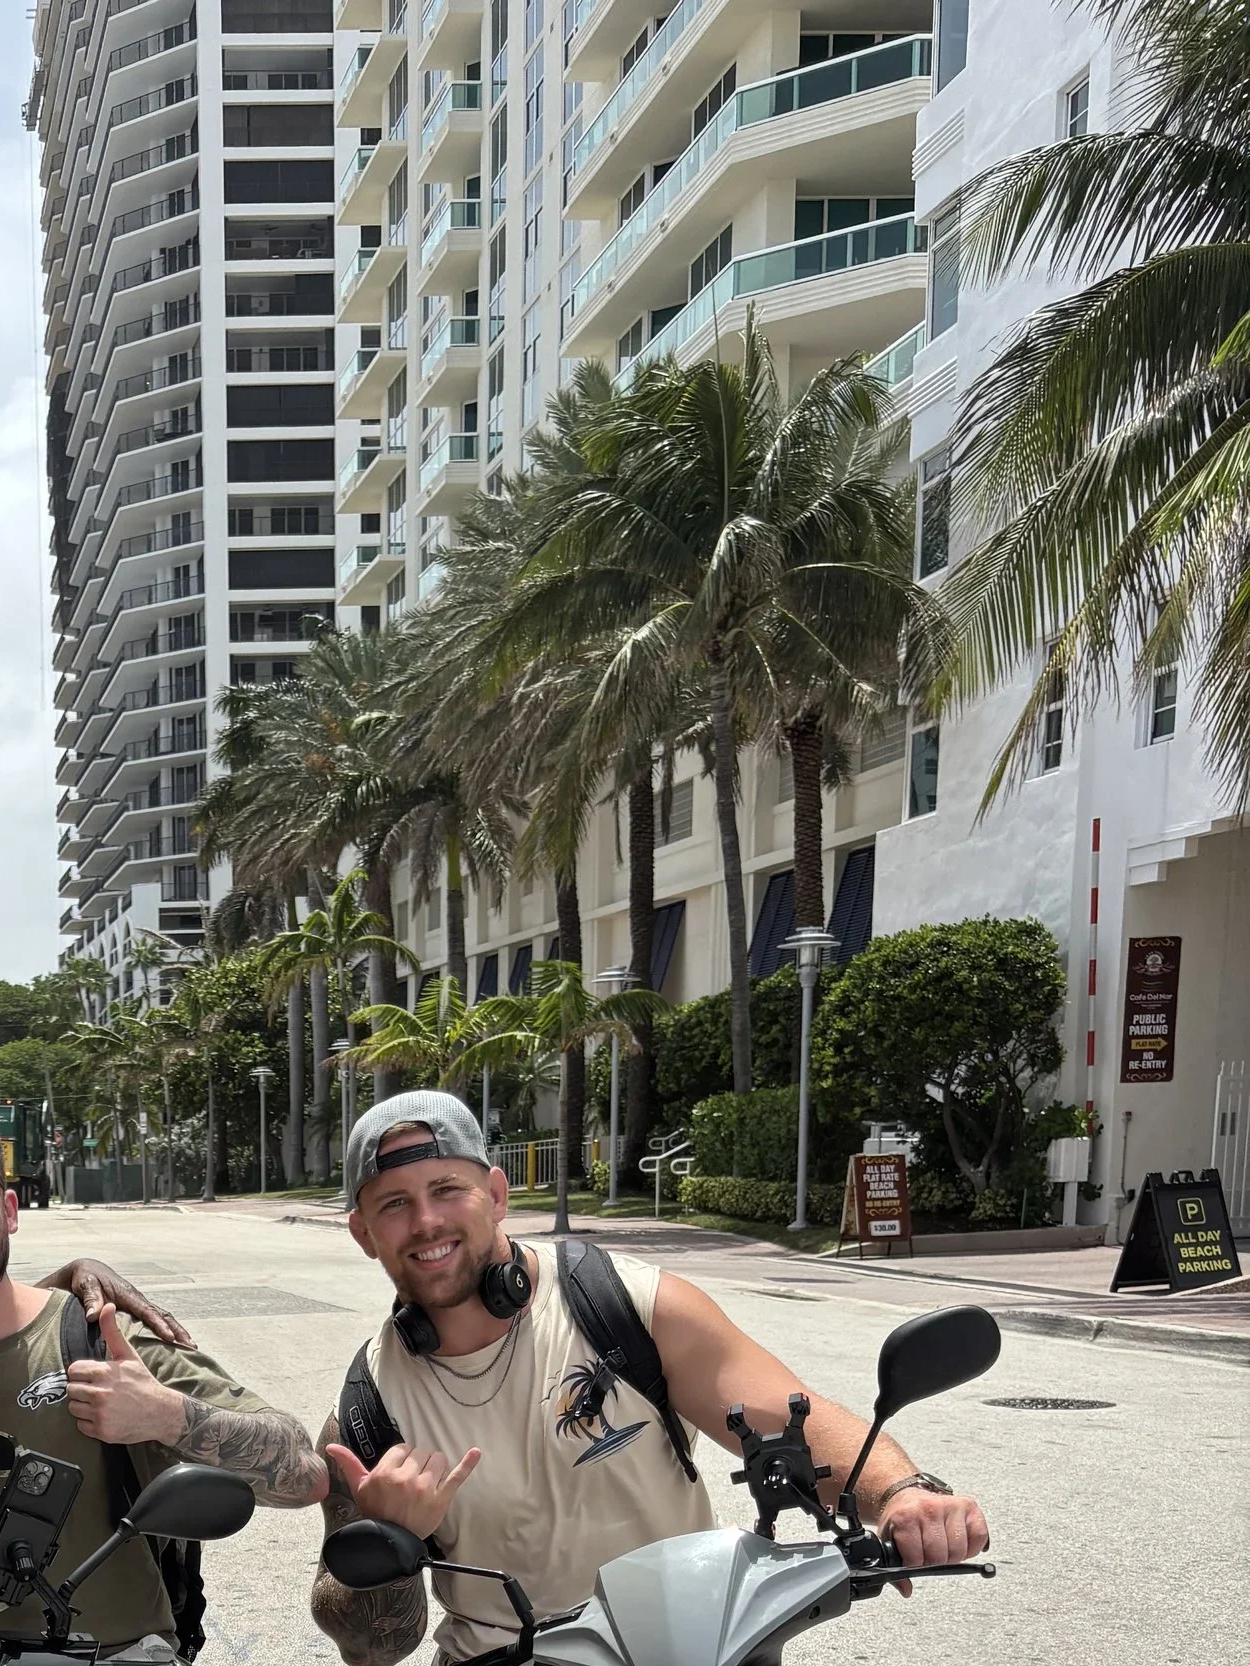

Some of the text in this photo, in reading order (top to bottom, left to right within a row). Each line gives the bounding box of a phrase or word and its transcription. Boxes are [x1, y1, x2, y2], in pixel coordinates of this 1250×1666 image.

[1133, 1014, 1166, 1024] PUBLIC
[1129, 1025, 1168, 1035] PARKING
[1143, 1051, 1154, 1060] NO
[1129, 1060, 1166, 1069] RE-ENTRY
[866, 1165, 895, 1174] ALL DAY
[863, 1173, 899, 1182] FLAT RATE
[870, 1182, 894, 1190] BEACH
[866, 1190, 898, 1199] PARKING
[1186, 1203, 1199, 1219] P
[1174, 1230, 1221, 1244] ALL DAY
[1180, 1245, 1221, 1258] BEACH
[1178, 1259, 1232, 1273] PARKING
